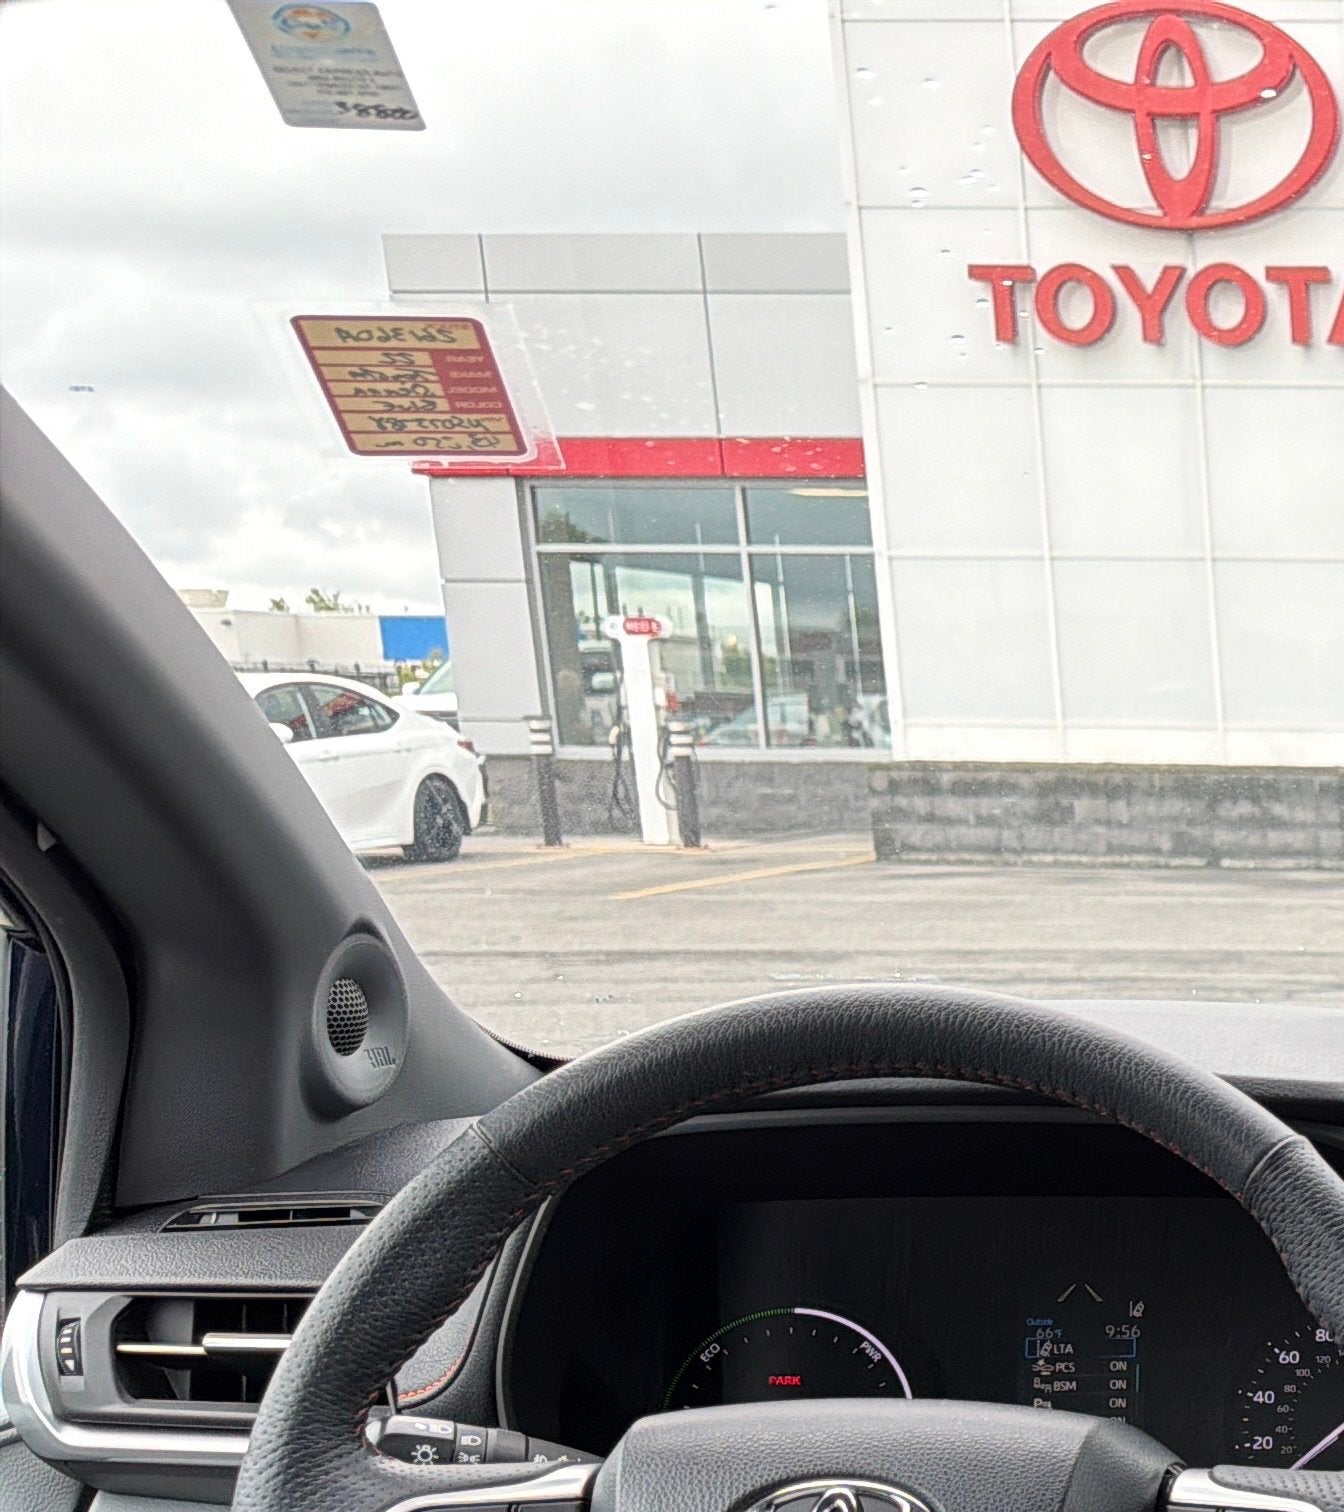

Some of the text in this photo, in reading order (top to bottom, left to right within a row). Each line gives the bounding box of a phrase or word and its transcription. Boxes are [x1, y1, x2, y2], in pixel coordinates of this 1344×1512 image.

[364, 1046, 397, 1068] JBL
[1105, 1325, 1141, 1338] 9:56
[700, 1342, 720, 1363] ECO
[859, 1340, 882, 1363] PWR
[1054, 1344, 1074, 1354] LTA
[1279, 1351, 1299, 1364] 60
[1055, 1361, 1127, 1372] PCS ON
[1295, 1369, 1310, 1377] 100
[768, 1375, 801, 1386] PARK
[1053, 1380, 1126, 1391] BSM ON
[1284, 1384, 1296, 1393] 80
[1109, 1398, 1126, 1408] ON
[1253, 1391, 1275, 1404] 40
[1277, 1405, 1289, 1413] 60
[1275, 1425, 1288, 1433] 40
[1252, 1436, 1273, 1449] 20
[1281, 1446, 1293, 1454] 20
